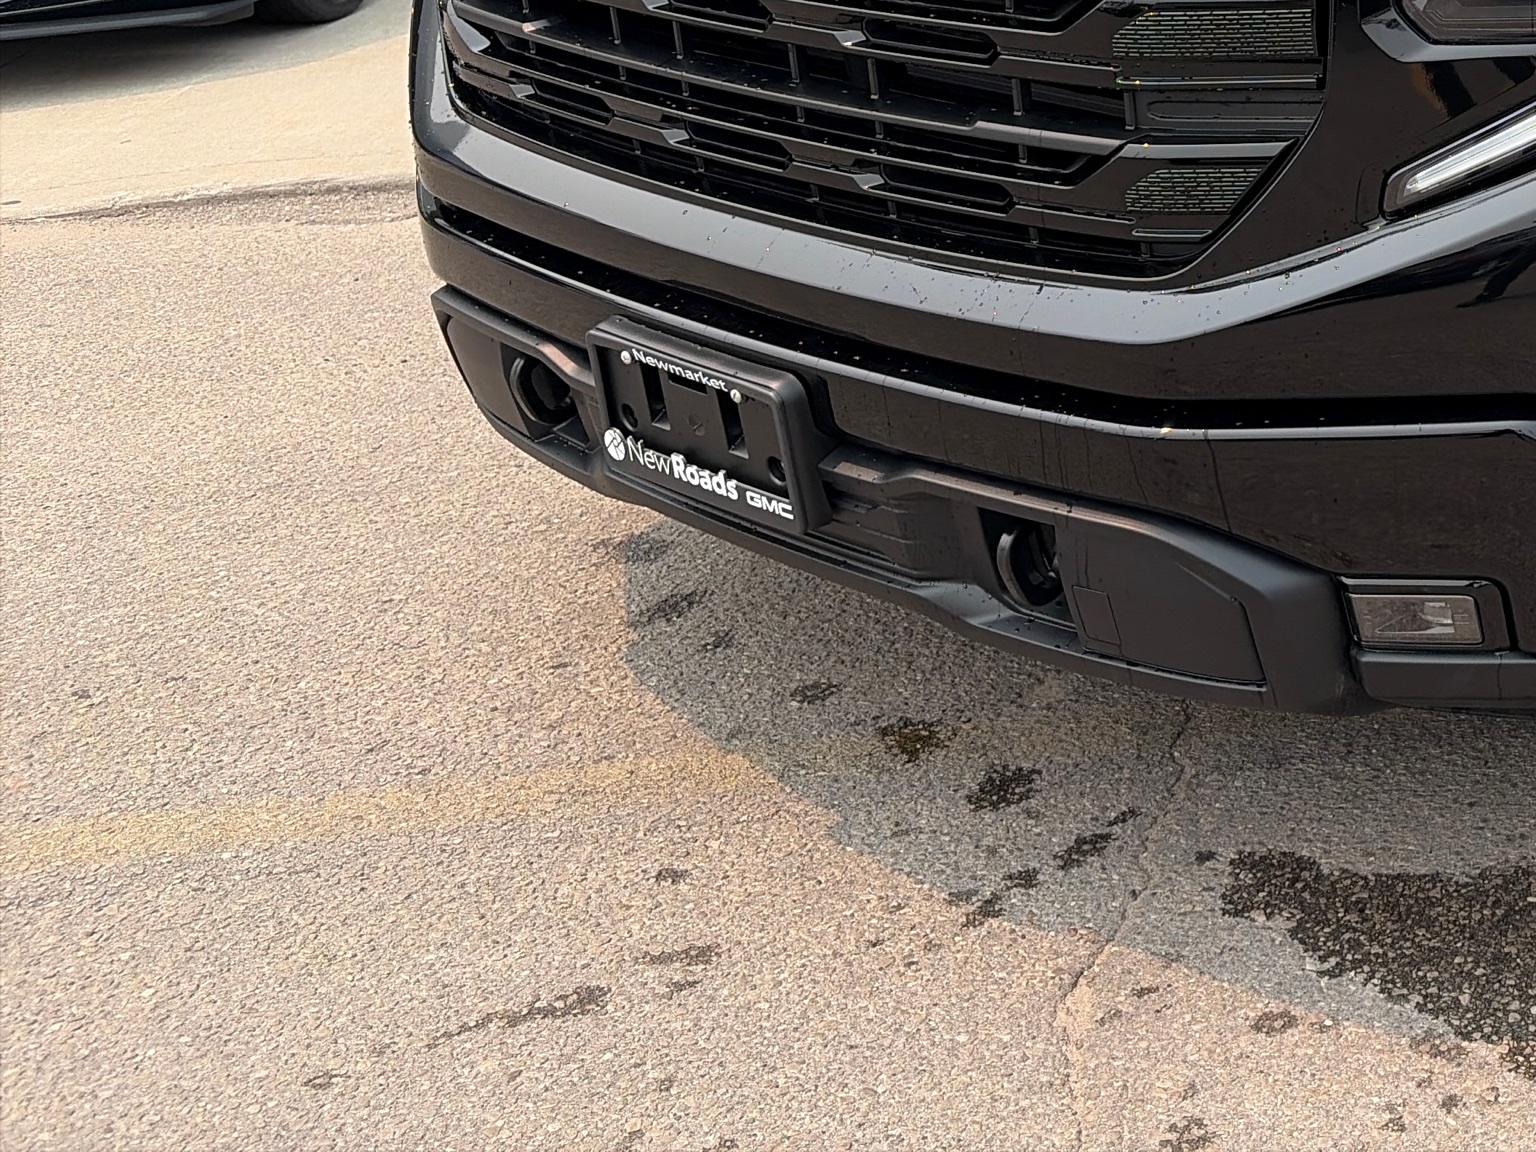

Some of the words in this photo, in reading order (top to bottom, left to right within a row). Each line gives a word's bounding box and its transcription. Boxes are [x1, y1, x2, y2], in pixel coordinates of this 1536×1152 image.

[631, 348, 729, 393] Newmarket
[626, 434, 739, 501] NewRoads
[745, 490, 795, 521] GMC
